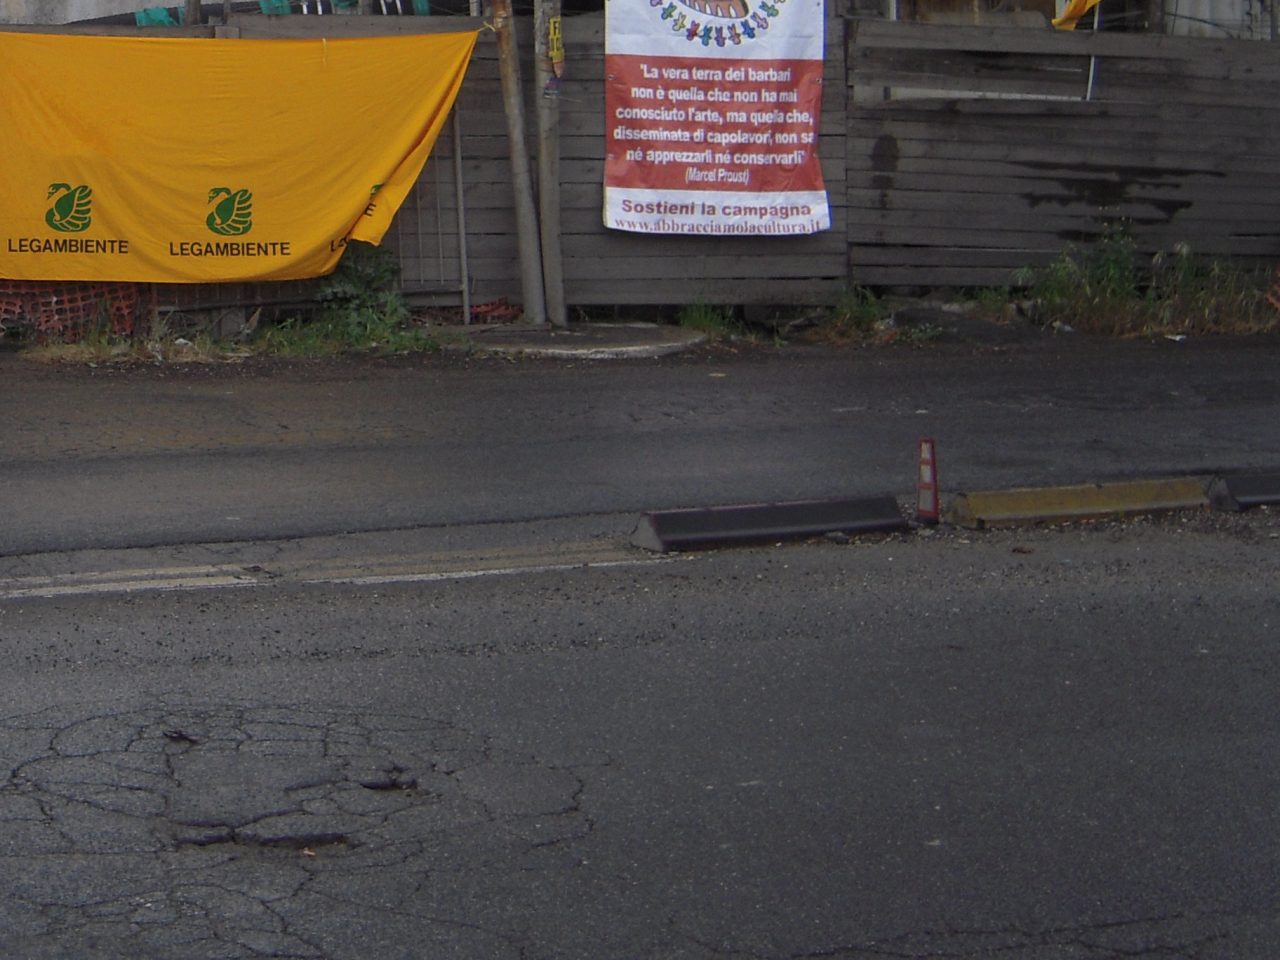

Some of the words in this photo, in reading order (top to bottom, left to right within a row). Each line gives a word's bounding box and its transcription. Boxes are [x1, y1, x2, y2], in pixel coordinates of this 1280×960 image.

[662, 67, 689, 80] vera
[692, 66, 722, 81] terra
[724, 67, 745, 81] dei
[748, 67, 791, 81] barbari
[631, 87, 654, 99] non
[656, 85, 665, 100] è
[668, 86, 705, 103] quella
[707, 87, 731, 102] che
[733, 91, 758, 102] non
[761, 88, 778, 102] ha
[779, 88, 798, 102] mai
[615, 106, 685, 120] conosciuto
[726, 111, 747, 122] ma
[785, 108, 814, 126] che,
[613, 125, 690, 141] disseminata
[693, 128, 705, 142] di
[775, 132, 798, 144] non
[626, 146, 643, 161] né
[646, 149, 712, 165] apprezzarli
[715, 150, 731, 164] né
[685, 166, 716, 185] (Marcel
[622, 199, 695, 215] Sostieni
[701, 202, 716, 216] la
[721, 204, 811, 219] campagna
[8, 237, 129, 254] LEGAMBIENTE
[169, 241, 291, 257] LEGAMBIENTE
